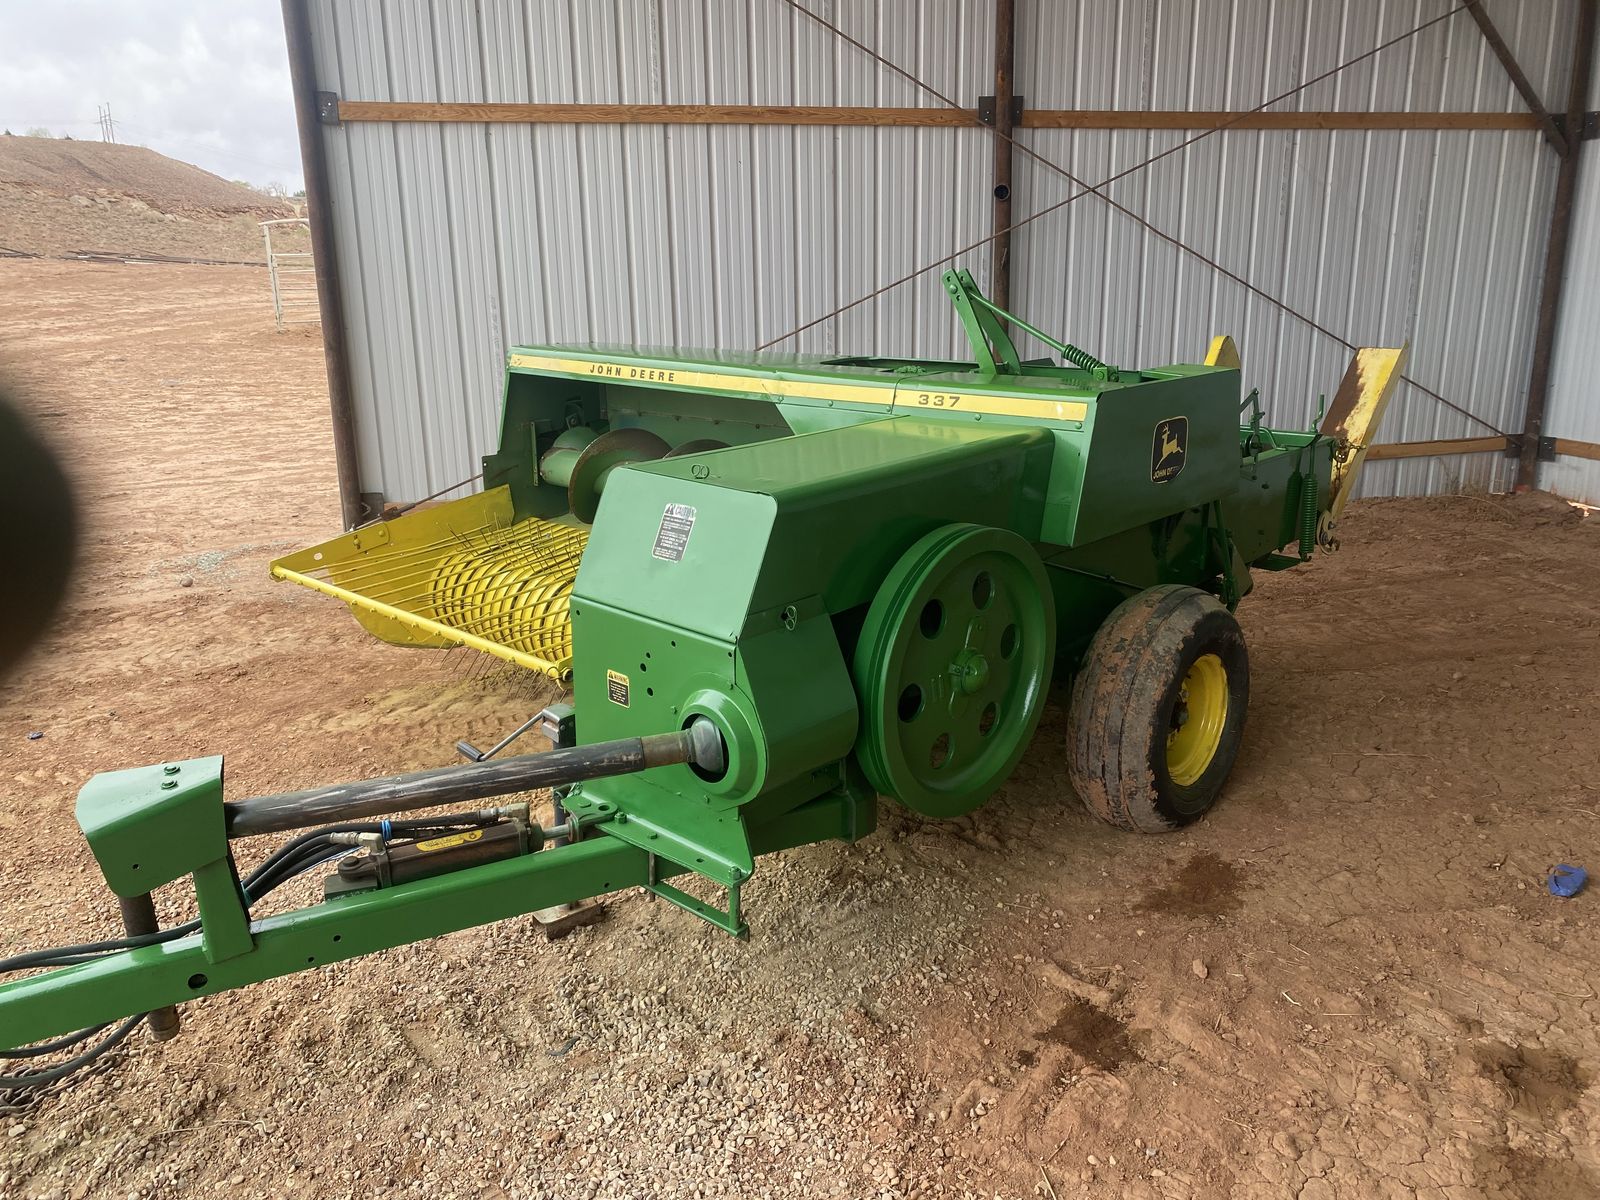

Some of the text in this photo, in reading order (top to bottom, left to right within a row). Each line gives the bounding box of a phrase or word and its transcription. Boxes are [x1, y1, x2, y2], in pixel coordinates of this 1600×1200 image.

[590, 364, 675, 382] JOHN DEERE
[918, 394, 961, 408] 337
[1153, 468, 1167, 480] JOHN
